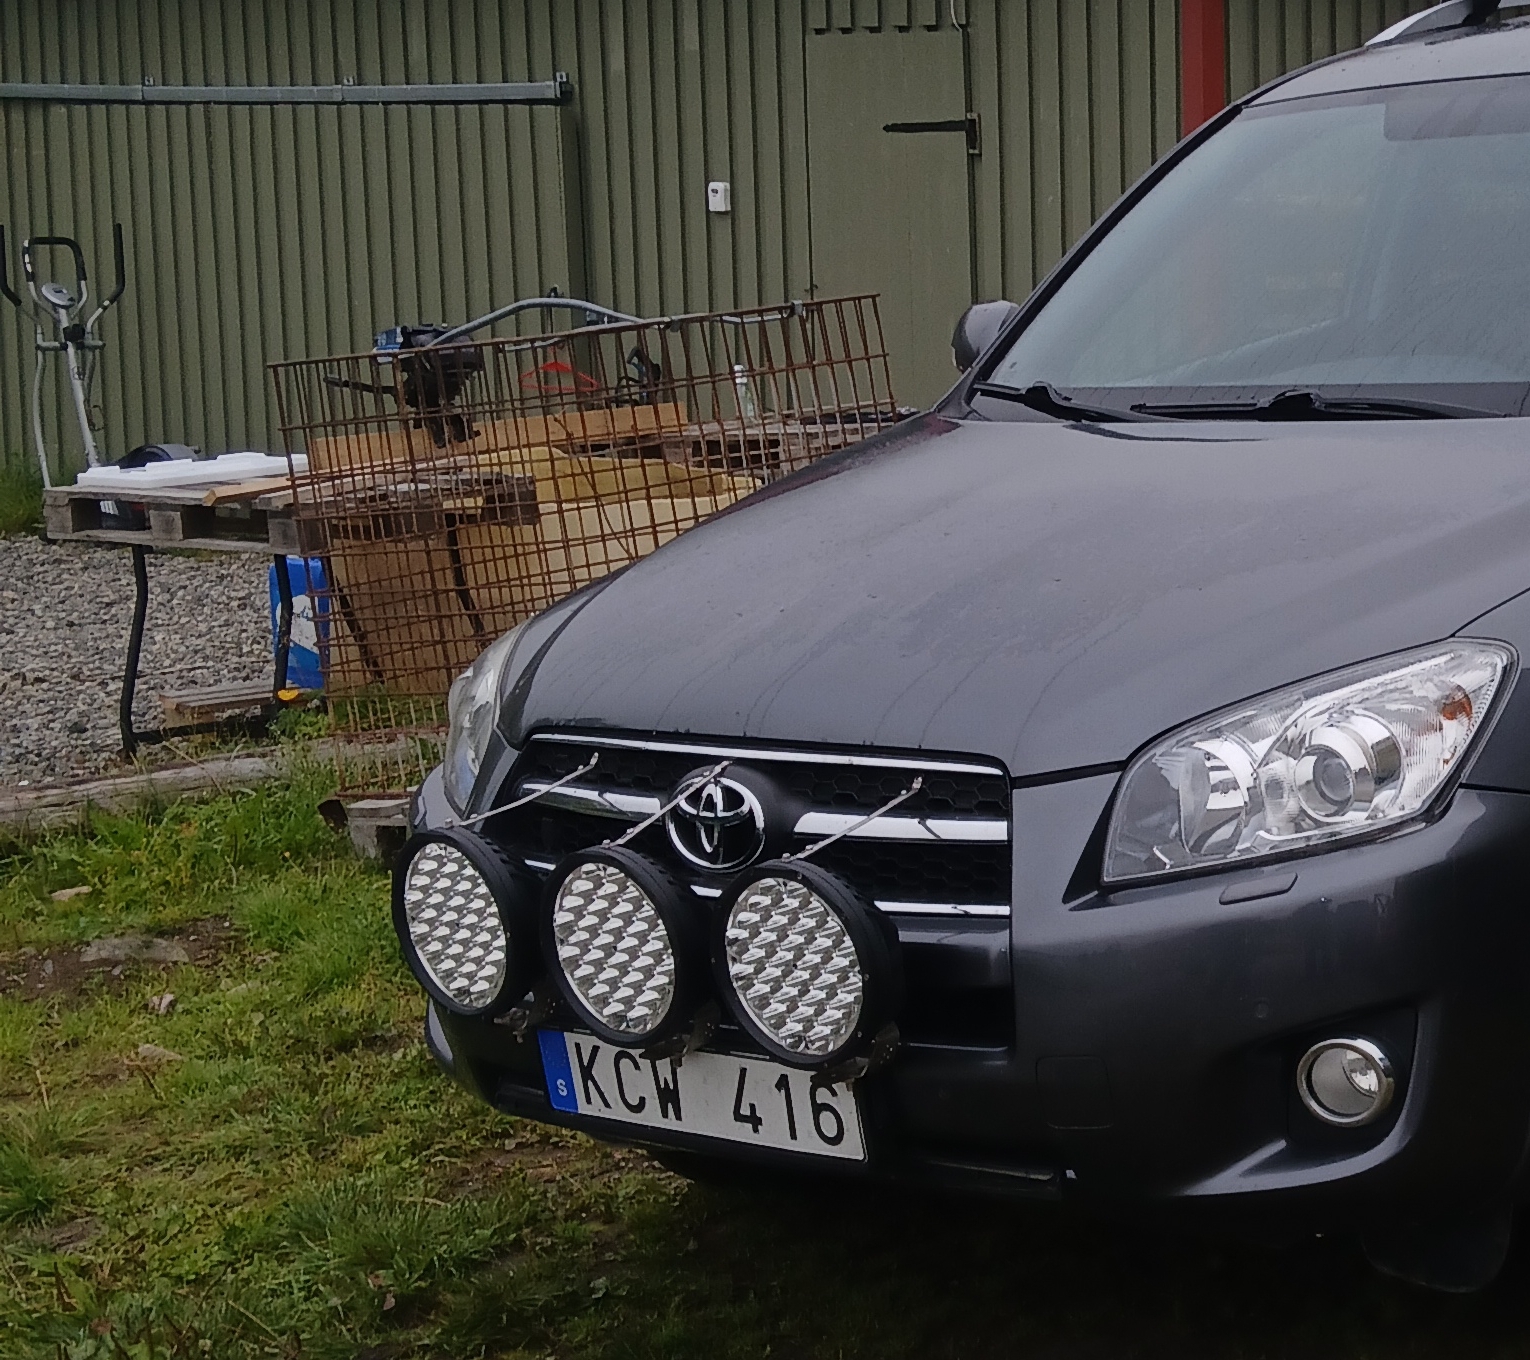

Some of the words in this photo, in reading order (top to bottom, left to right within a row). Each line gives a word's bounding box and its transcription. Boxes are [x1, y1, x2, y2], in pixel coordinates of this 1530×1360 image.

[557, 1079, 568, 1096] S
[574, 1042, 682, 1121] KCW
[733, 1067, 845, 1146] 416
